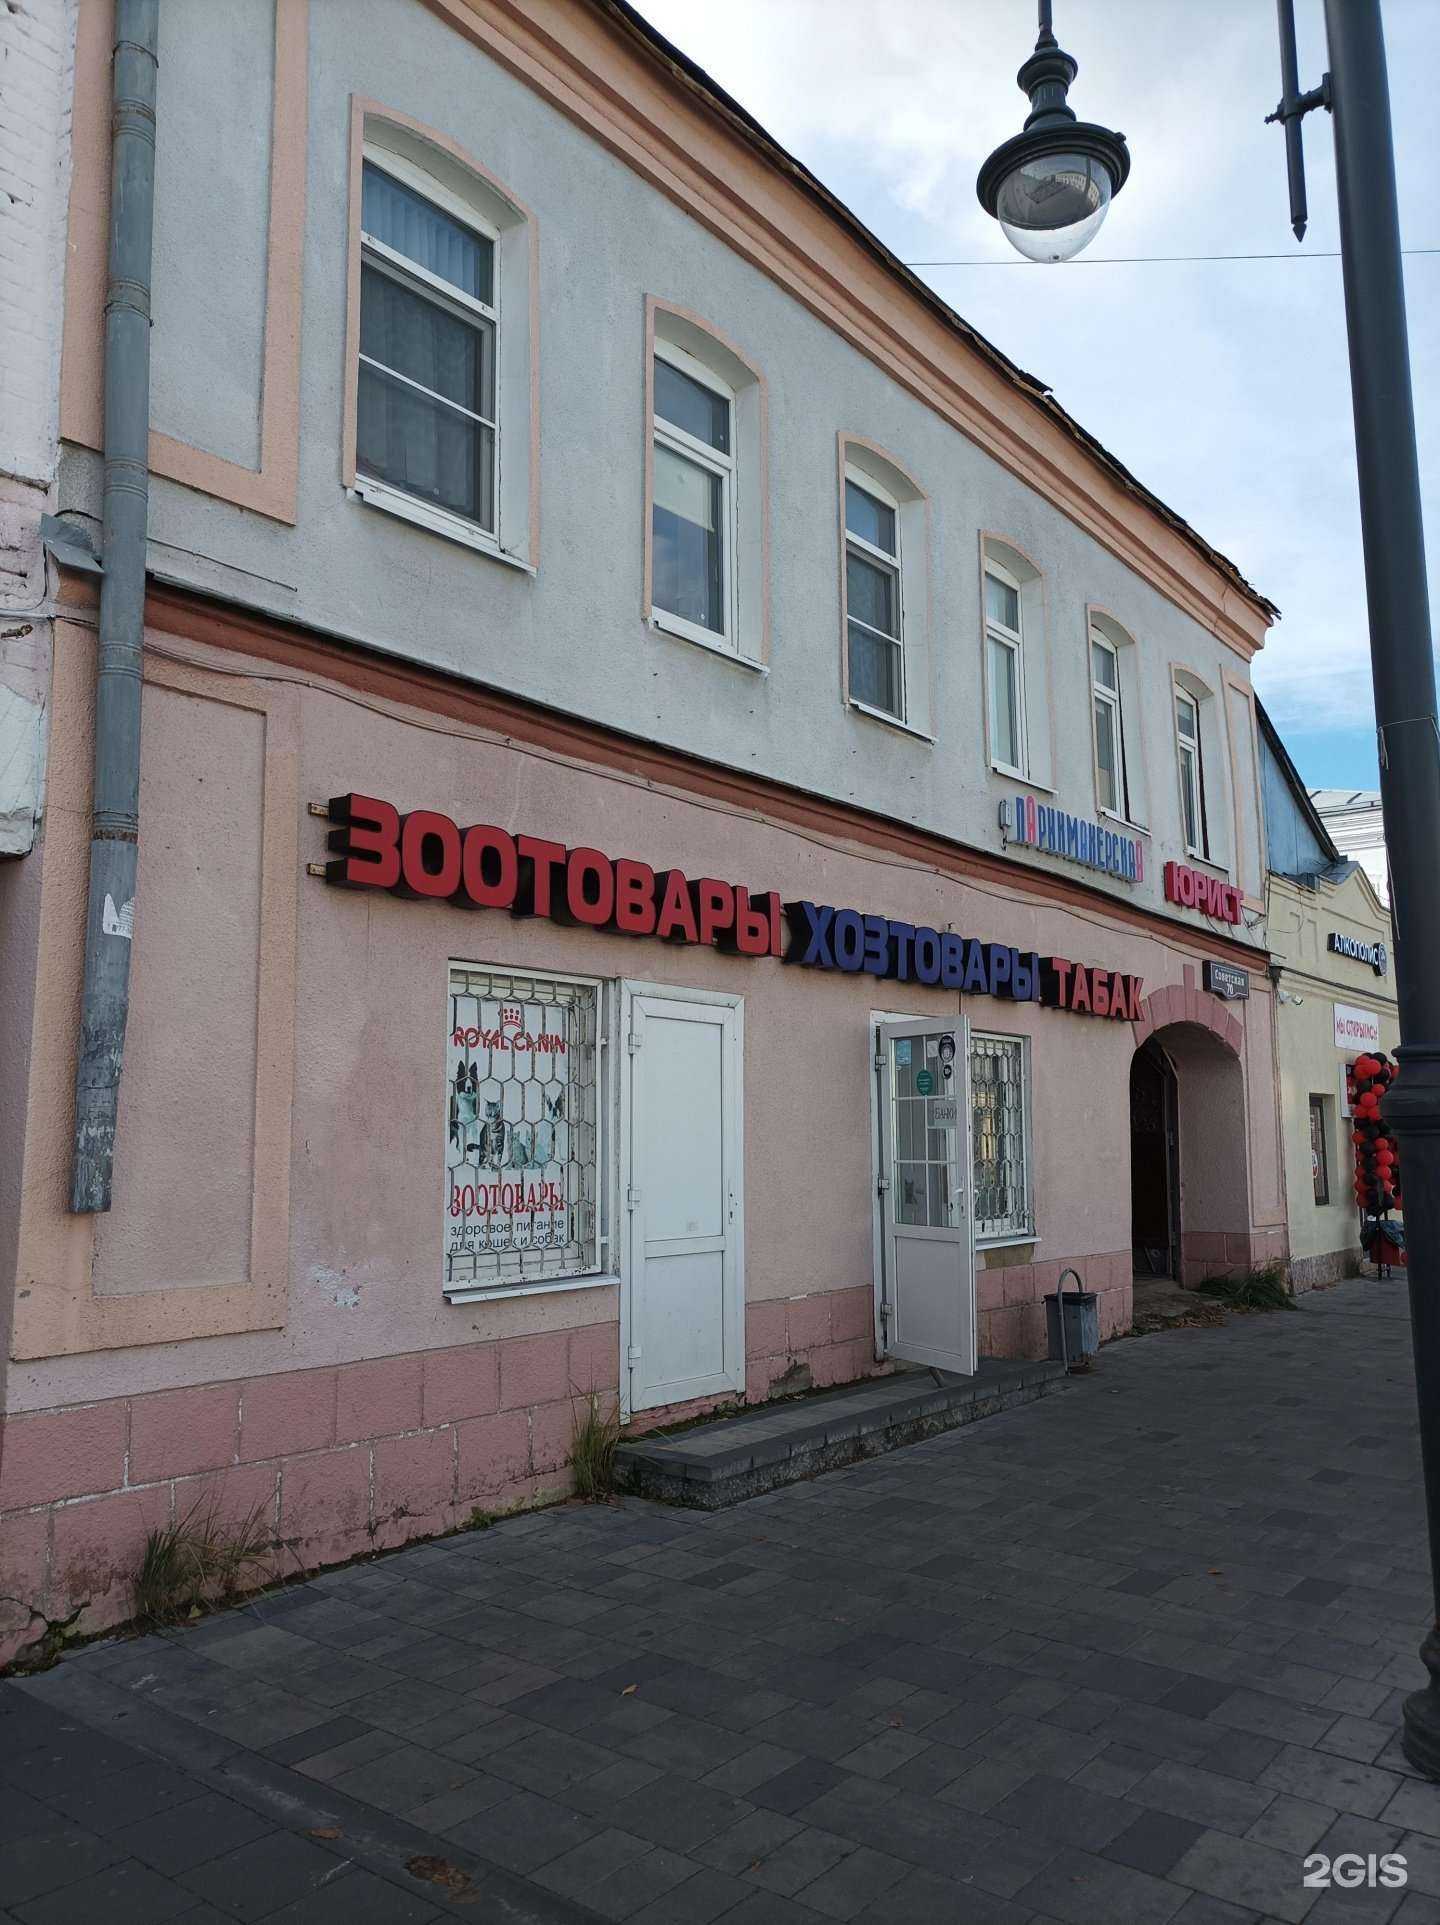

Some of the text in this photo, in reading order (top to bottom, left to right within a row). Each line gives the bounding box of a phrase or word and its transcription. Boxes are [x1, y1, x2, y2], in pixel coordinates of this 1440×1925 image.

[1015, 795, 1144, 882] ПАРИКМАХЕРСКАЯ
[346, 792, 1144, 1022] ЗООТОВАРЫ ХОЗТОВАРЫ ТАБАК
[1168, 861, 1243, 925] ЮРИСТ
[1334, 932, 1380, 965] АЛКОПОЛИС
[453, 1026, 566, 1054] ROYAL CANIN
[450, 1182, 565, 1217] ЗООТОВАРЫ
[450, 1222, 512, 1239] здоровое
[520, 1236, 528, 1246] и
